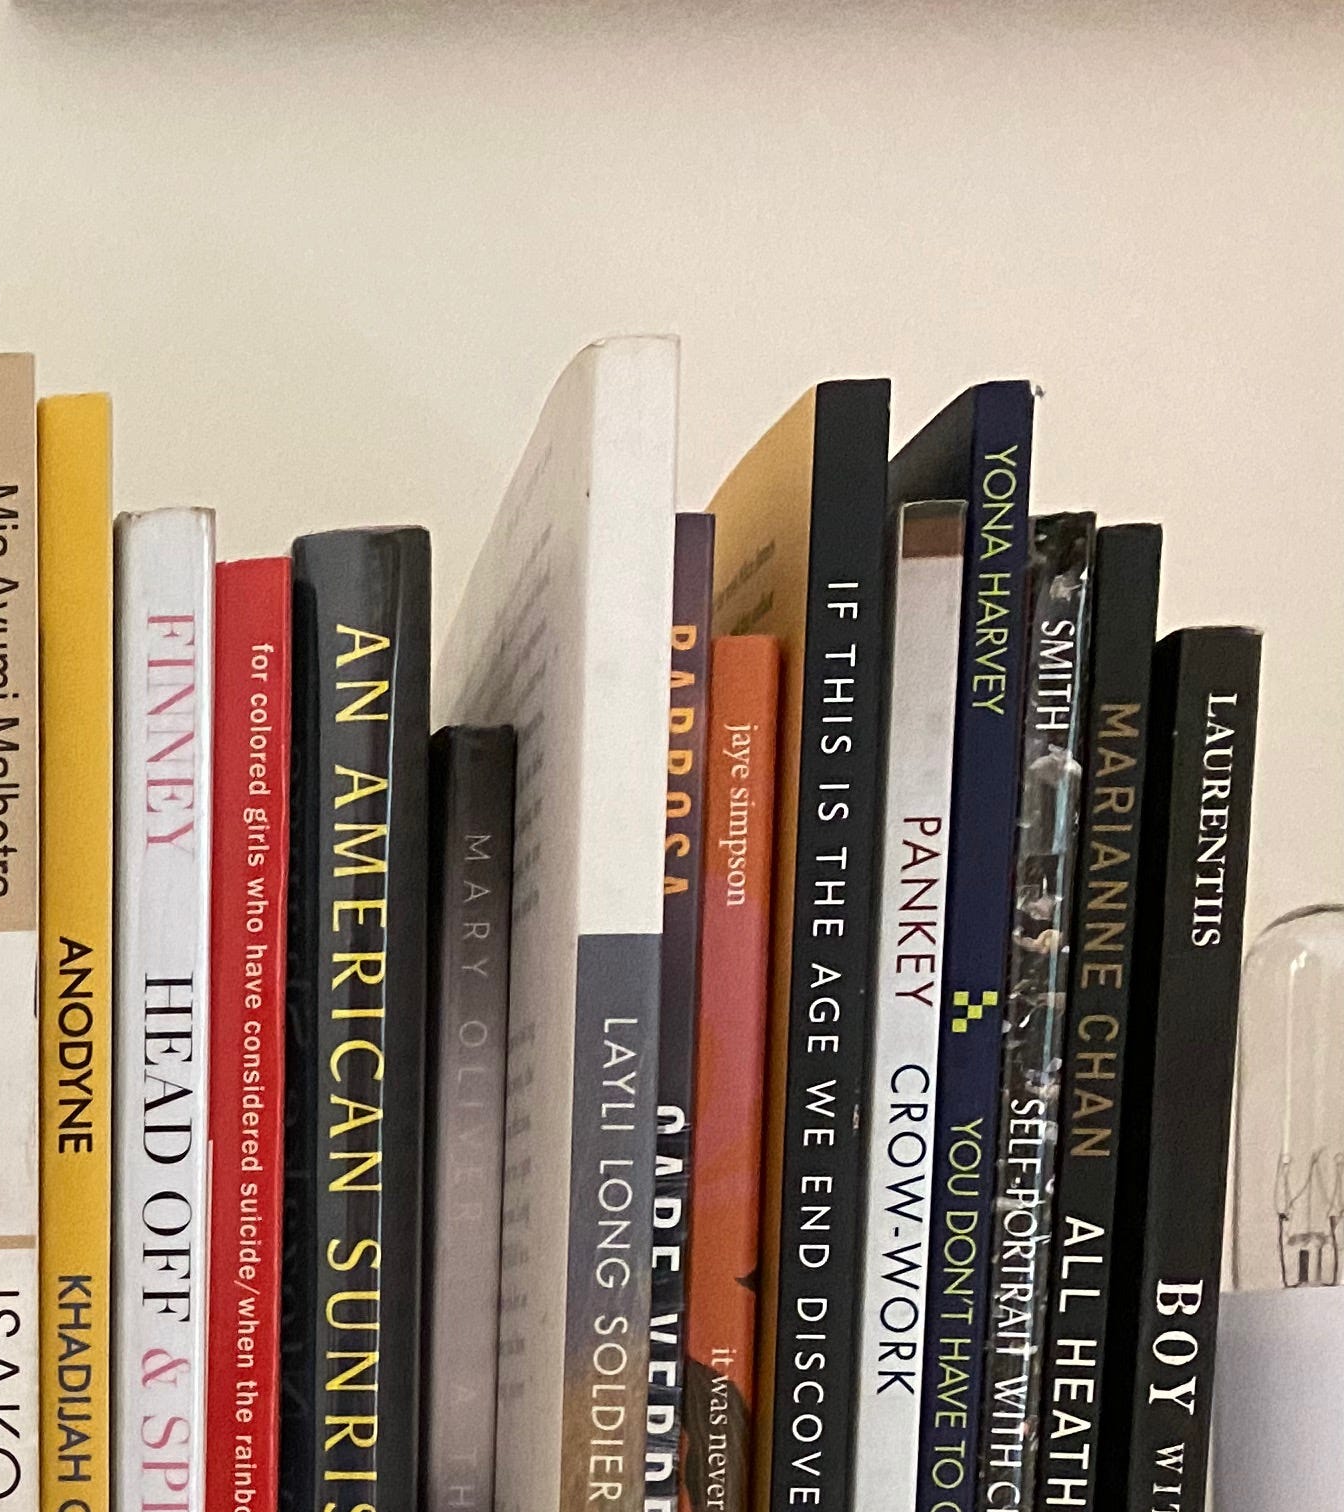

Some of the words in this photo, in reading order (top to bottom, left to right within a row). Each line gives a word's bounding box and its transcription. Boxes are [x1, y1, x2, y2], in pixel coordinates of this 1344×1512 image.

[979, 444, 1019, 562] YONA
[827, 581, 859, 620] IF
[971, 571, 1012, 717] HARVEY
[334, 623, 391, 723] AN
[819, 642, 857, 755] THIS
[145, 606, 197, 865] FINNEY
[817, 782, 850, 823] IS
[1078, 702, 1141, 991] MARIANNE
[811, 845, 849, 938] THE
[329, 763, 389, 1193] AMERICAN
[806, 961, 841, 1054] AGE
[142, 971, 195, 1165] HEAD
[802, 1078, 838, 1148] WE
[1069, 1014, 1121, 1158] CHAN
[945, 1117, 984, 1197] YOU
[140, 1190, 193, 1323] OFF
[798, 1175, 833, 1270] END
[939, 1209, 980, 1327] DON'T
[1058, 1214, 1106, 1314] ALL
[140, 1347, 192, 1390] &
[710, 1346, 737, 1367] it
[933, 1337, 971, 1430] HAVE
[1147, 1277, 1205, 1416] BOY
[708, 1378, 730, 1427] was
[705, 1434, 728, 1511] never
[931, 1439, 966, 1490] TO
